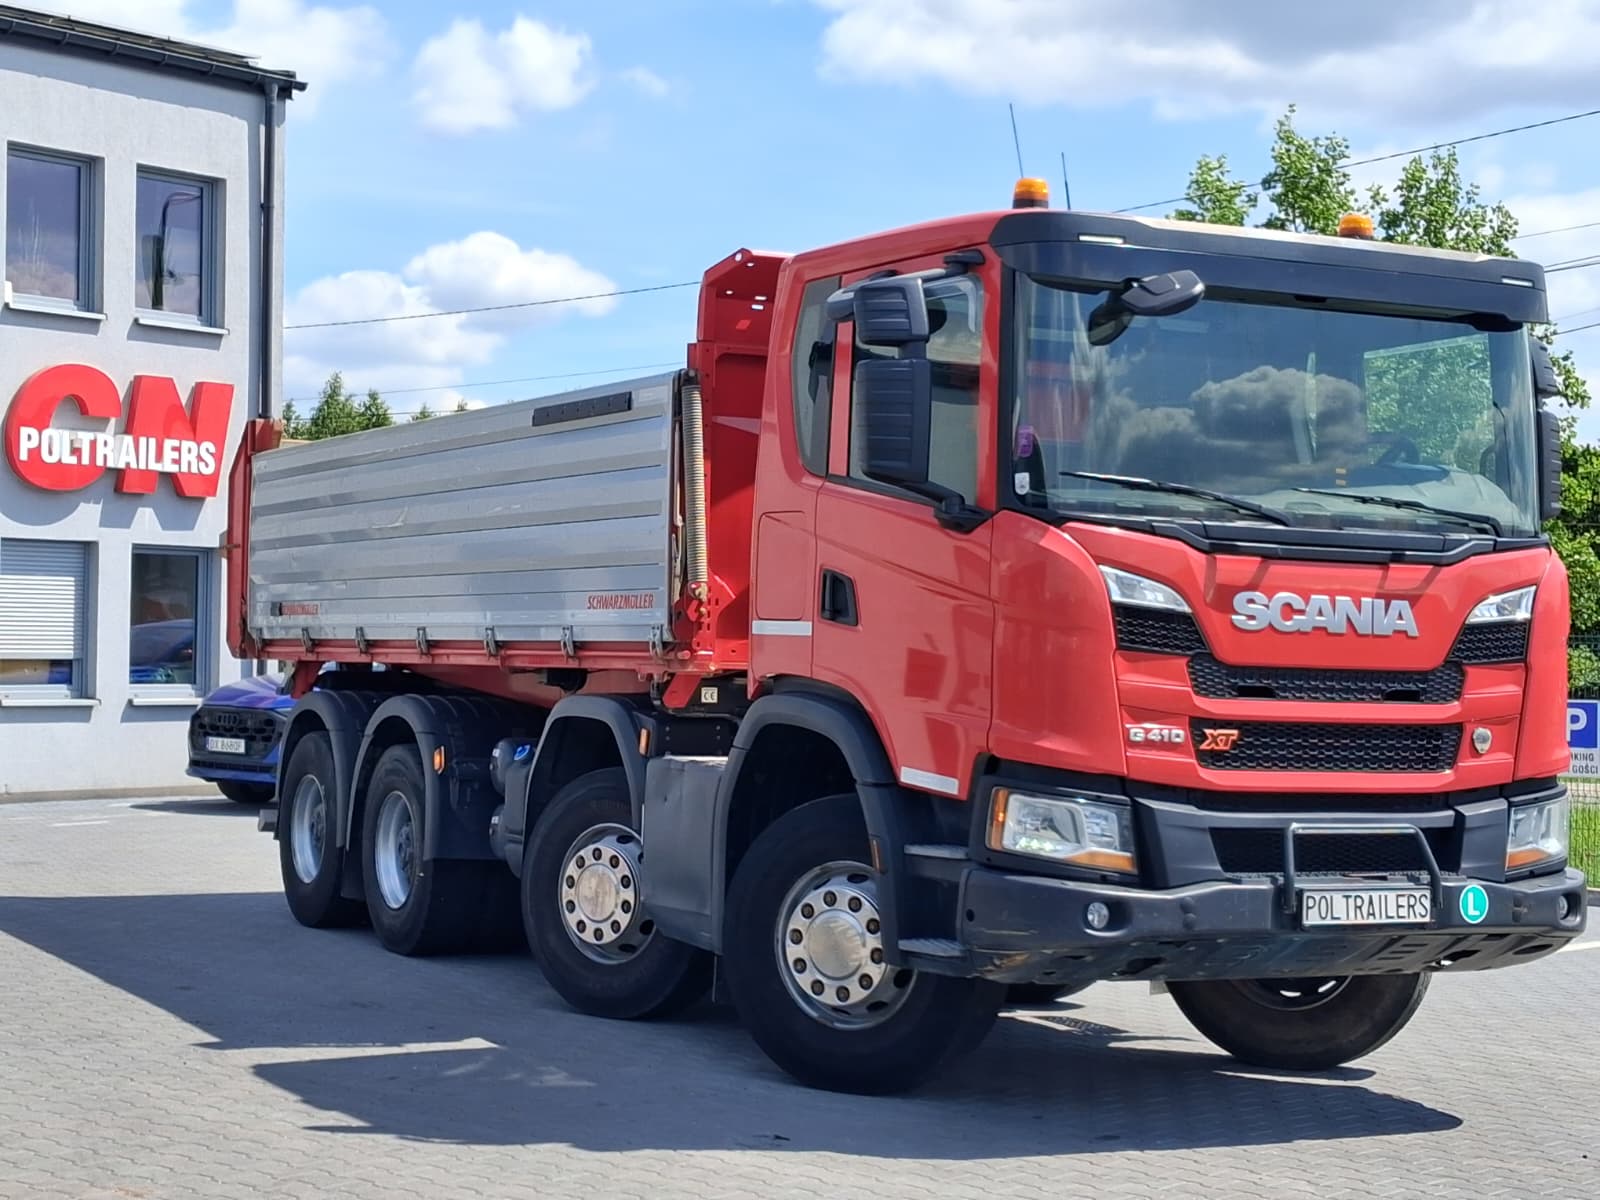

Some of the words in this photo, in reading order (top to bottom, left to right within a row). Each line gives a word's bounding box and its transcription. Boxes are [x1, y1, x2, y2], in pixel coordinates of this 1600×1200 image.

[18, 426, 216, 475] POLTRAILERS
[1231, 591, 1419, 637] SCANIA
[1200, 729, 1239, 750] XT
[1566, 707, 1587, 742] P
[1468, 892, 1480, 916] L
